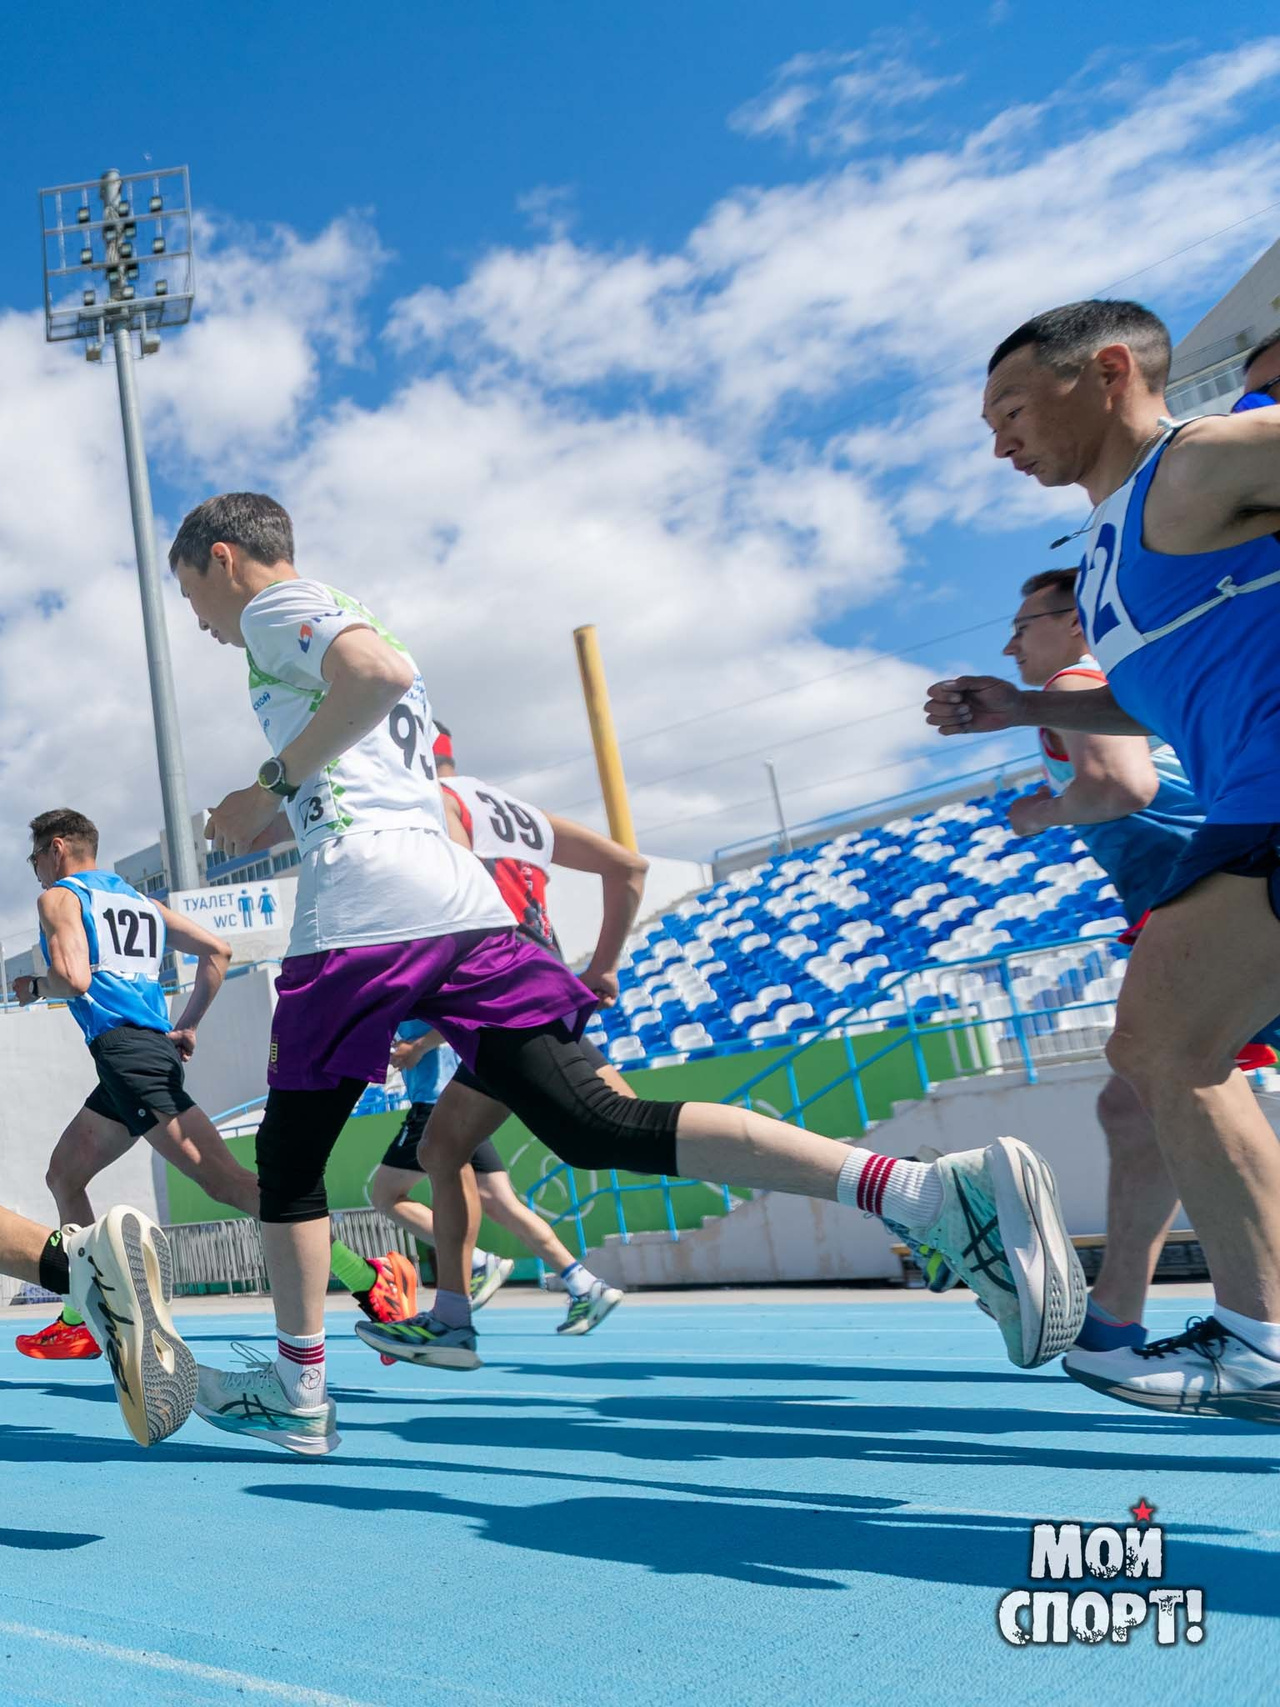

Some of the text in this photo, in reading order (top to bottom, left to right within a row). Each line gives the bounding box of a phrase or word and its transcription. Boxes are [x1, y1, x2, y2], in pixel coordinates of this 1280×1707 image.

[475, 790, 545, 851] 39
[183, 893, 235, 912] ТУАЛЕТ
[102, 907, 157, 958] 127
[213, 913, 238, 928] WC
